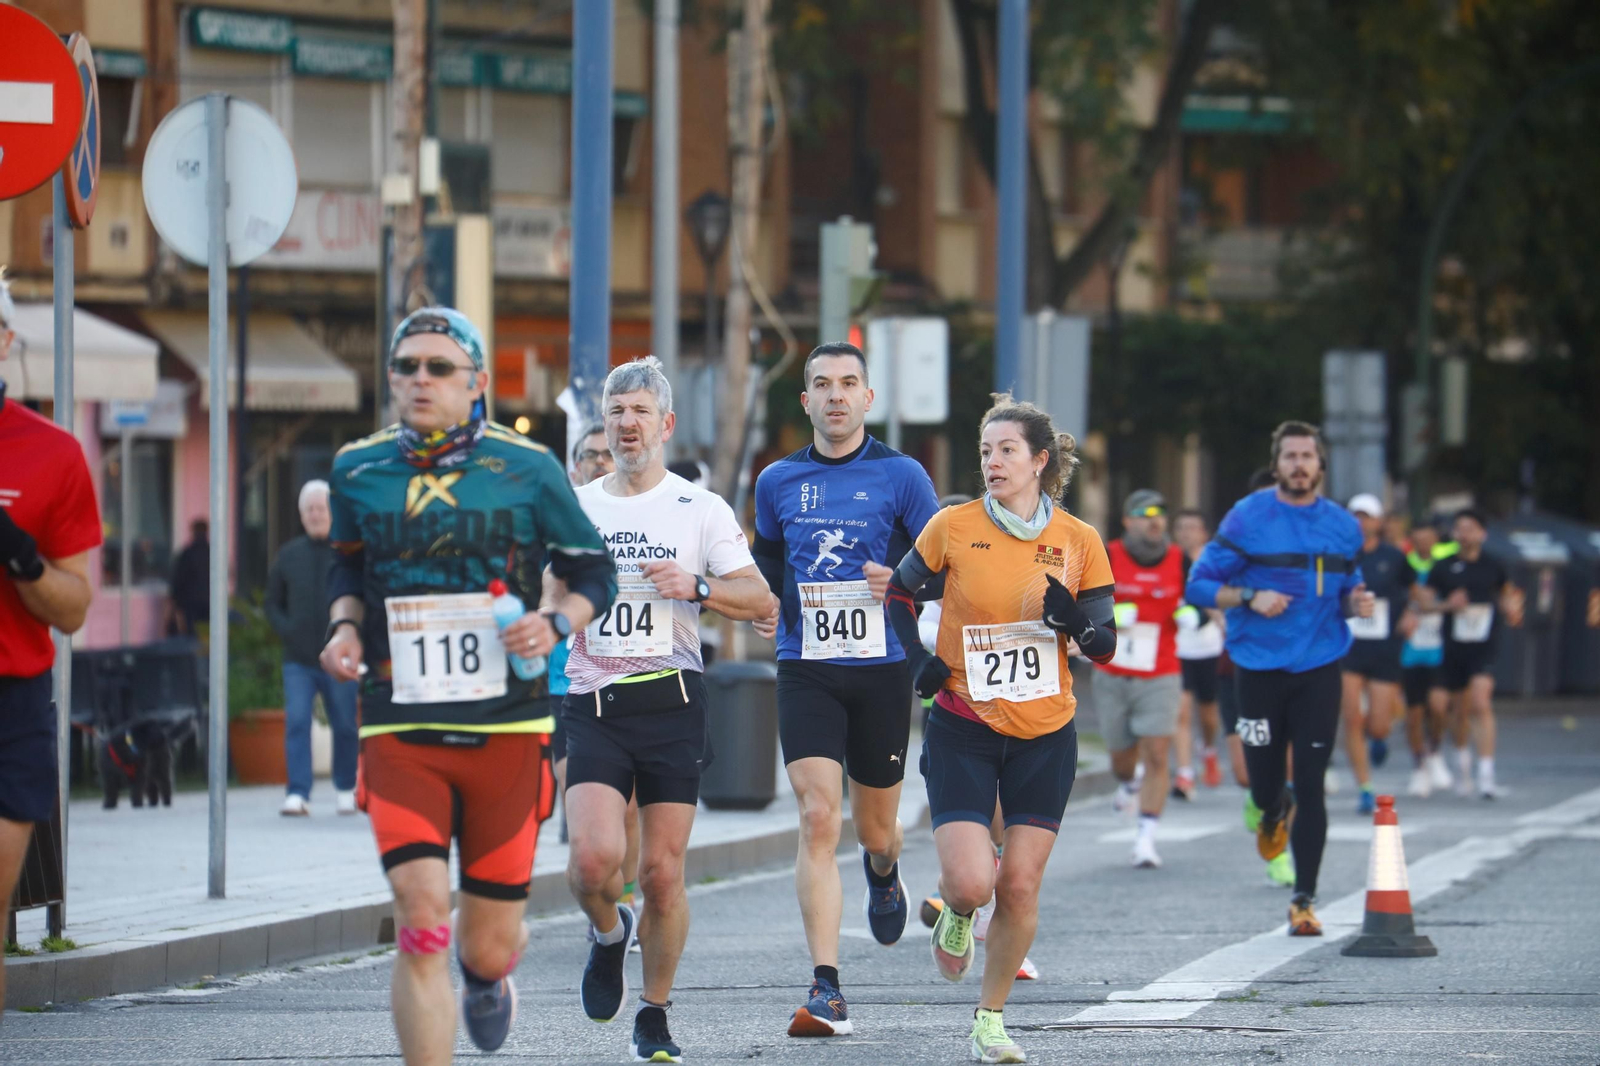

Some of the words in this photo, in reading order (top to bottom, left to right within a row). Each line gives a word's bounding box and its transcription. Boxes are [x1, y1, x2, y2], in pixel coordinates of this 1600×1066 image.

[406, 473, 464, 518] IX
[603, 531, 649, 544] MEDIA
[1034, 553, 1064, 562] ATLETISMO
[802, 585, 824, 608] XLI
[598, 602, 654, 637] 204
[815, 608, 867, 642] 840
[412, 632, 480, 676] 118
[966, 628, 994, 652] XLI
[984, 646, 1041, 686] 279
